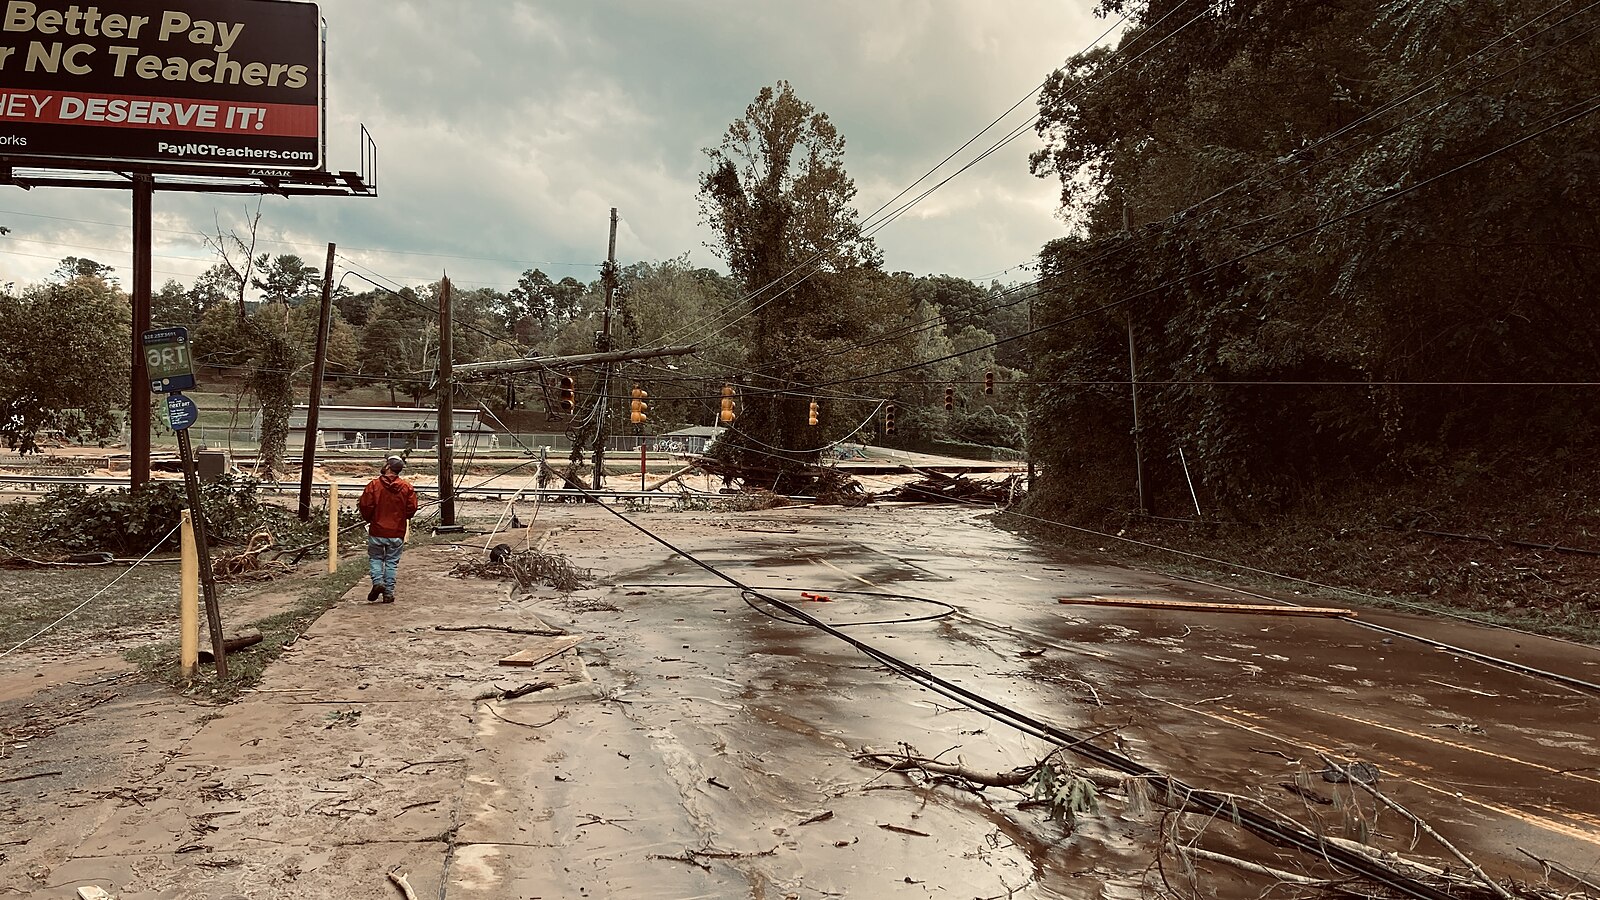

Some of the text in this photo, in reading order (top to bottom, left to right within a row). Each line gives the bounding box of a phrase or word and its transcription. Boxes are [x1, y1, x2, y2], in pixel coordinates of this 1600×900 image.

[3, 1, 245, 52] Better Pay
[25, 41, 96, 75] NC
[108, 45, 309, 88] Teachers
[59, 97, 219, 127] DESERVE
[225, 106, 266, 130] IT!
[158, 142, 313, 160] PayNCTeachers.com
[251, 169, 292, 177] LAMAR
